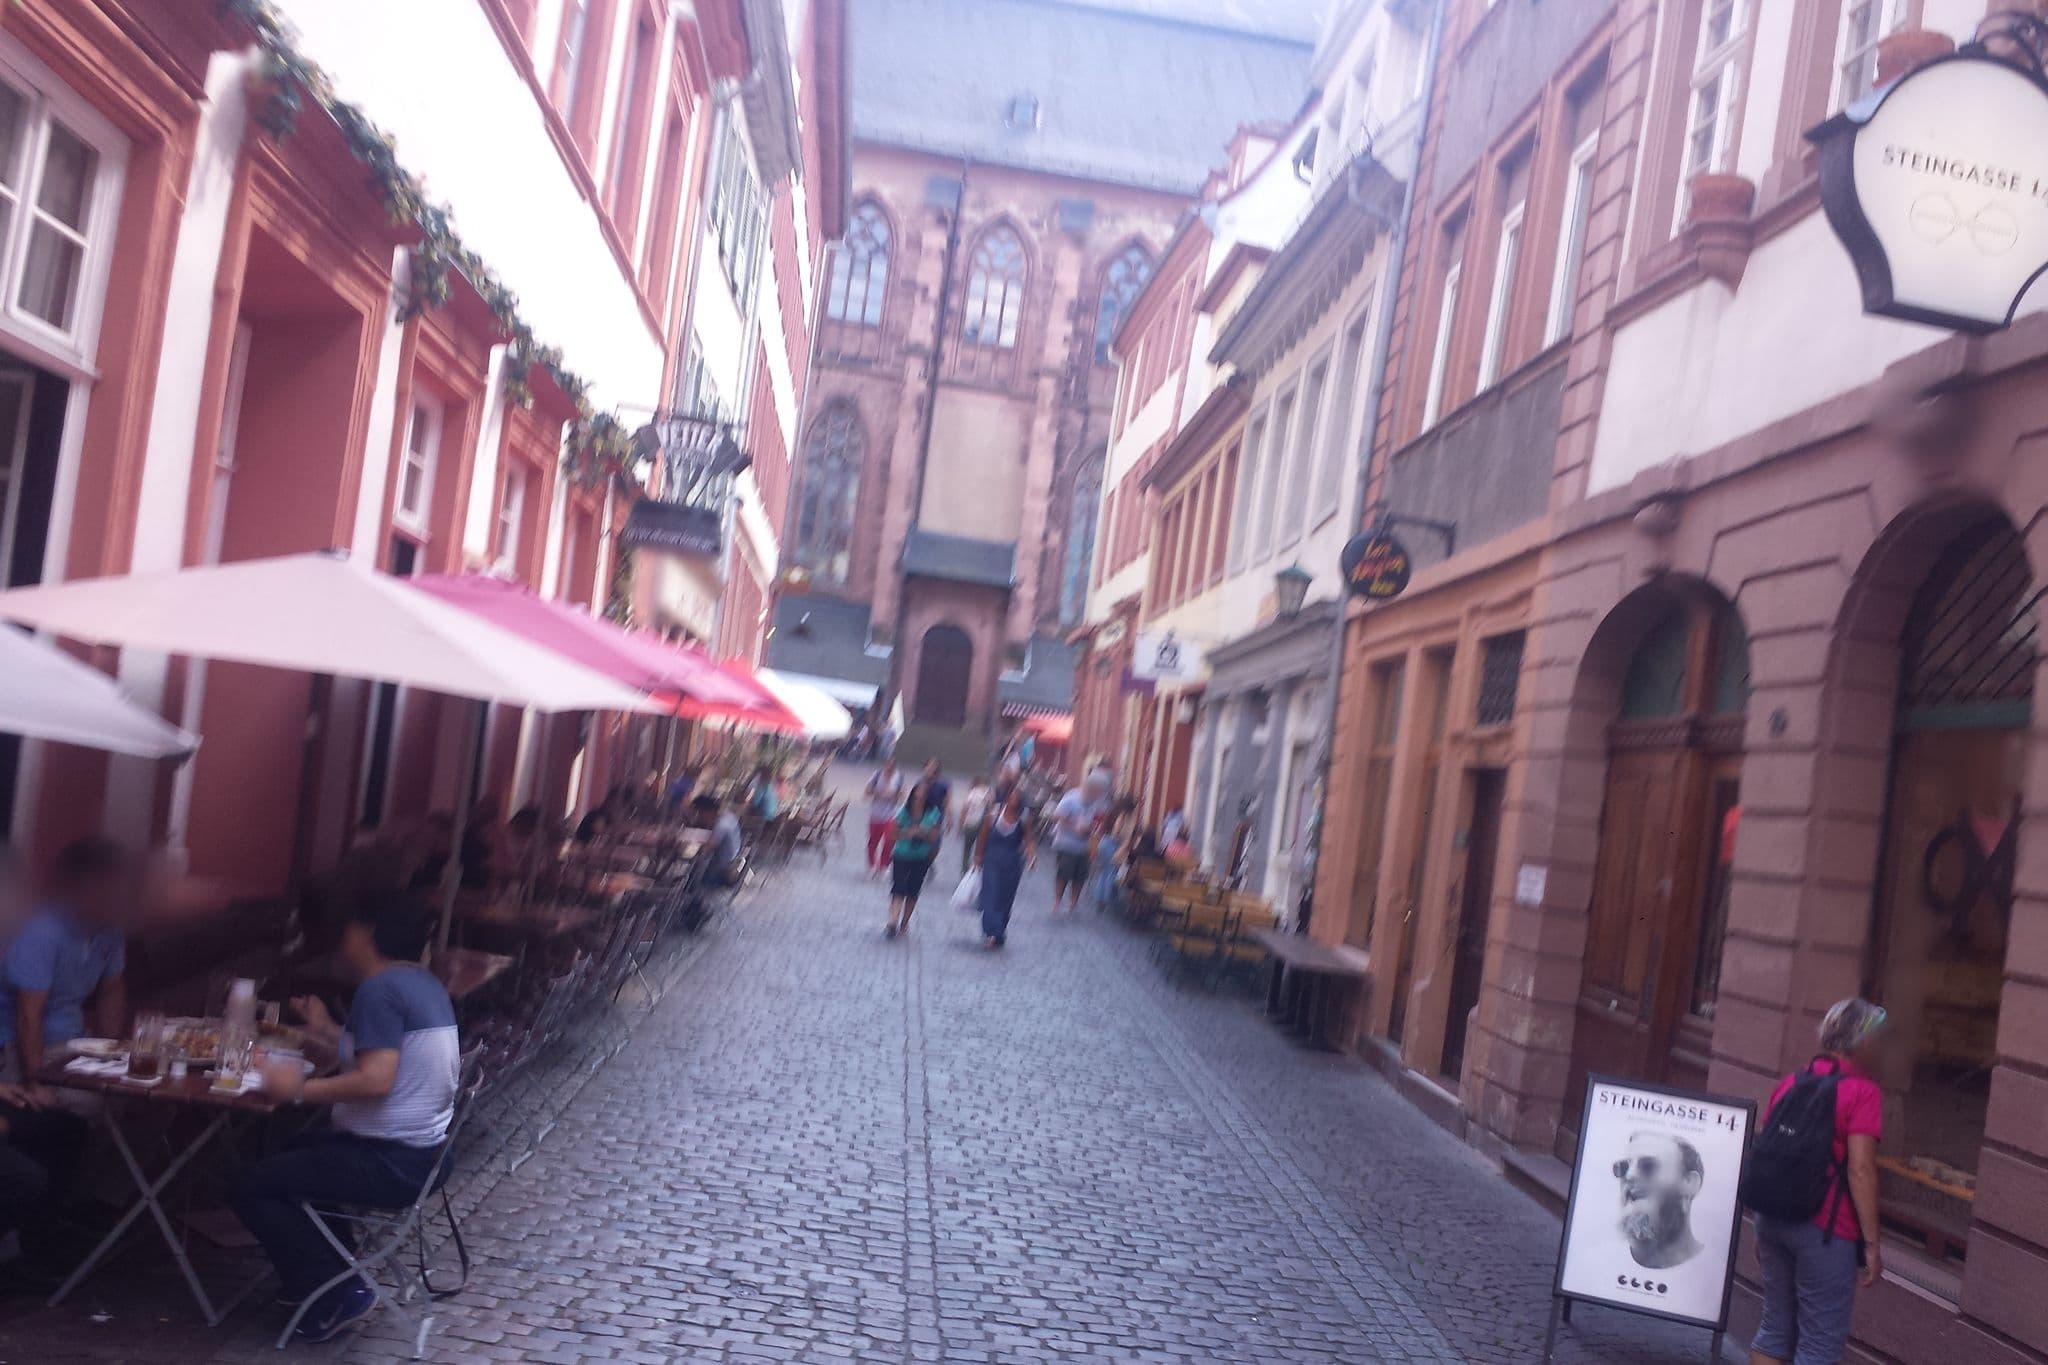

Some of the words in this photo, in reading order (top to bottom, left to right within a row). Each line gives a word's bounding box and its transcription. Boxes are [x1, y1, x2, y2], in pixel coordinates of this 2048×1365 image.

[1882, 144, 2021, 194] STEINGASSE
[1600, 1090, 1708, 1121] STEINGASSE
[1717, 1113, 1739, 1132] 14
